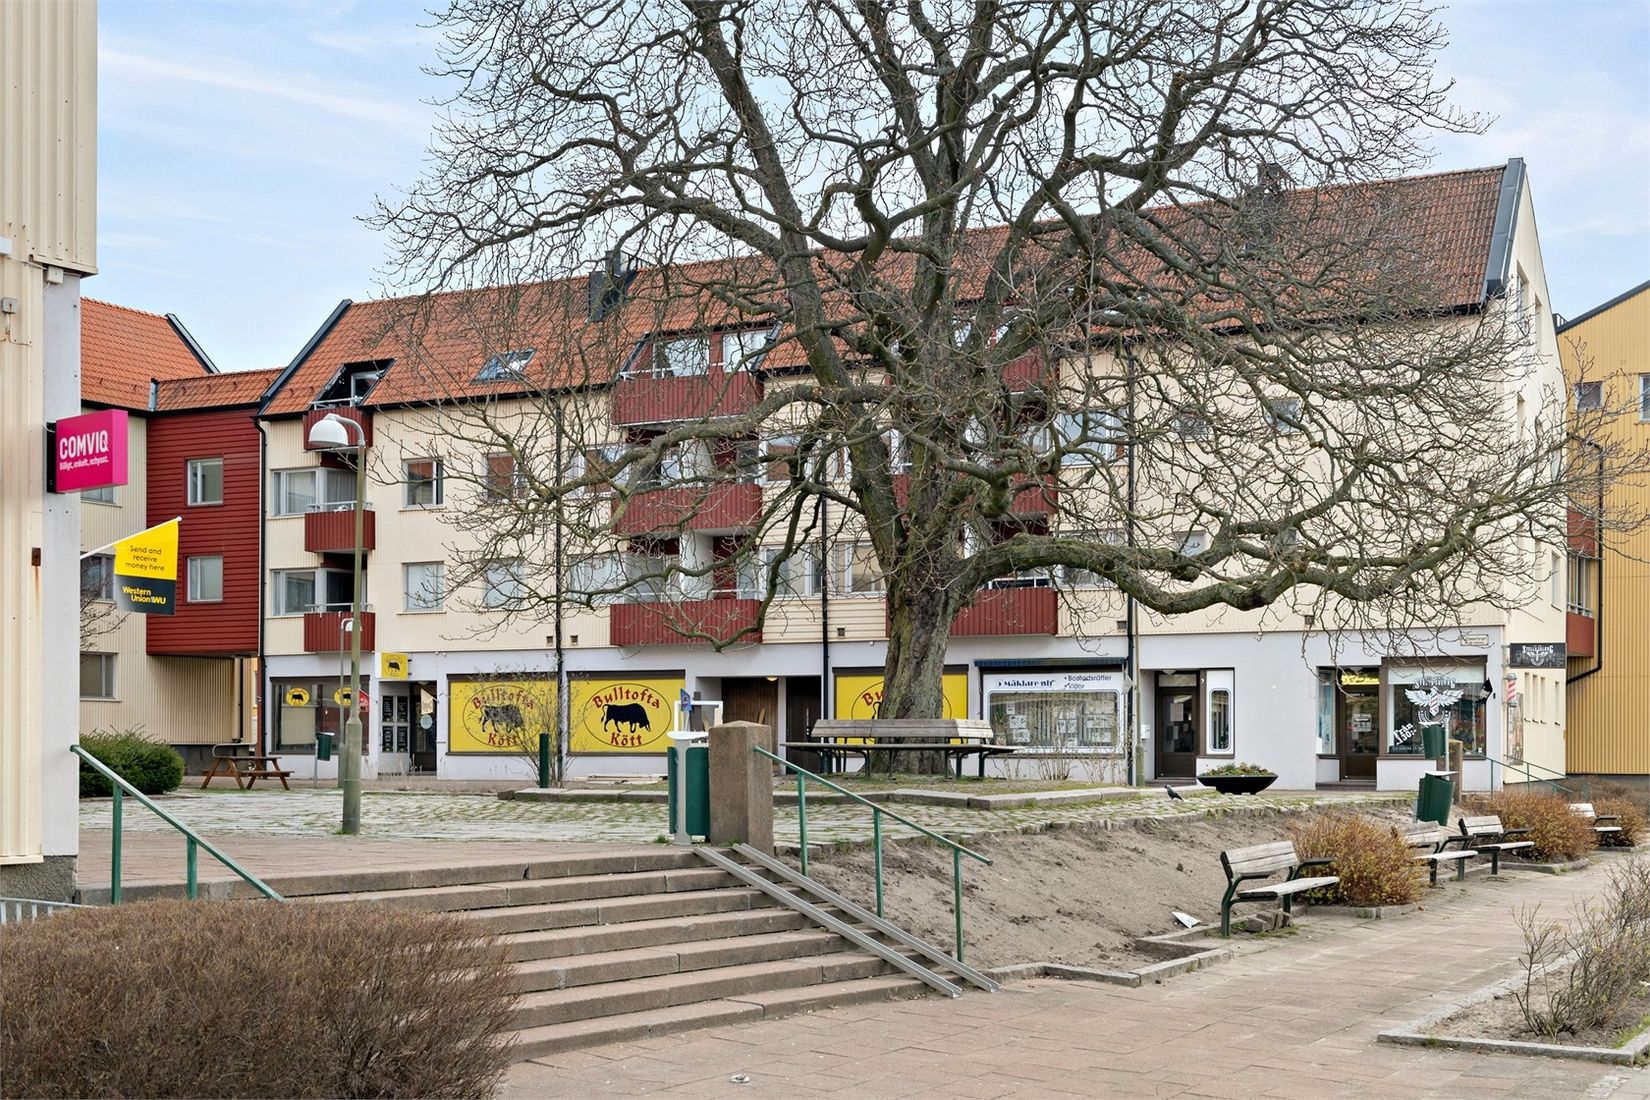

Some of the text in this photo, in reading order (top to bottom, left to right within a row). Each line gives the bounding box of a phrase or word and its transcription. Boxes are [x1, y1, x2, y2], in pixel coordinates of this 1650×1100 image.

[60, 430, 109, 460] COMVIQ
[129, 545, 162, 555] Send and
[125, 562, 148, 570] money
[122, 586, 151, 596] Western
[1068, 674, 1111, 682] Bostadsrätter
[472, 688, 534, 710] Bulltofta
[592, 686, 660, 709] Bulltofta
[488, 732, 519, 747] Kött
[610, 731, 642, 746] Kött
